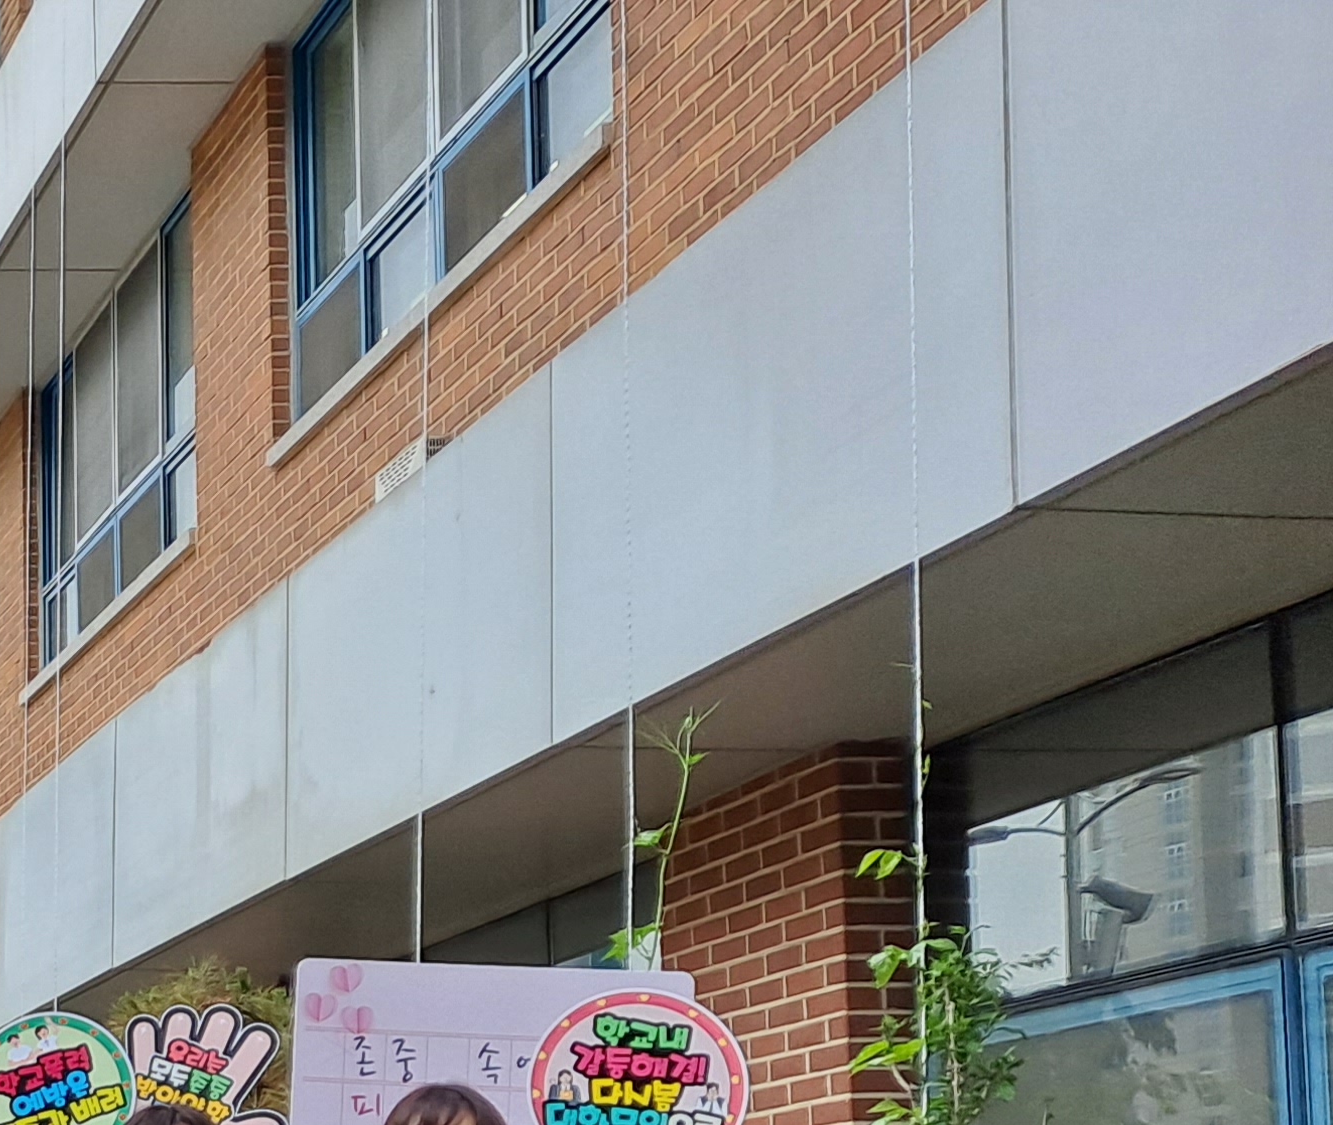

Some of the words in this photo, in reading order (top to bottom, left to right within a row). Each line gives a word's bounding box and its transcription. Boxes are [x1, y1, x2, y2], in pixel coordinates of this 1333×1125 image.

[595, 1014, 690, 1050] 학교내
[167, 1038, 228, 1074] 우리는
[354, 1036, 418, 1083] 존중
[572, 1044, 709, 1084] 갈등해결!
[12, 1069, 89, 1116] 예방은
[69, 1085, 125, 1123] 배려
